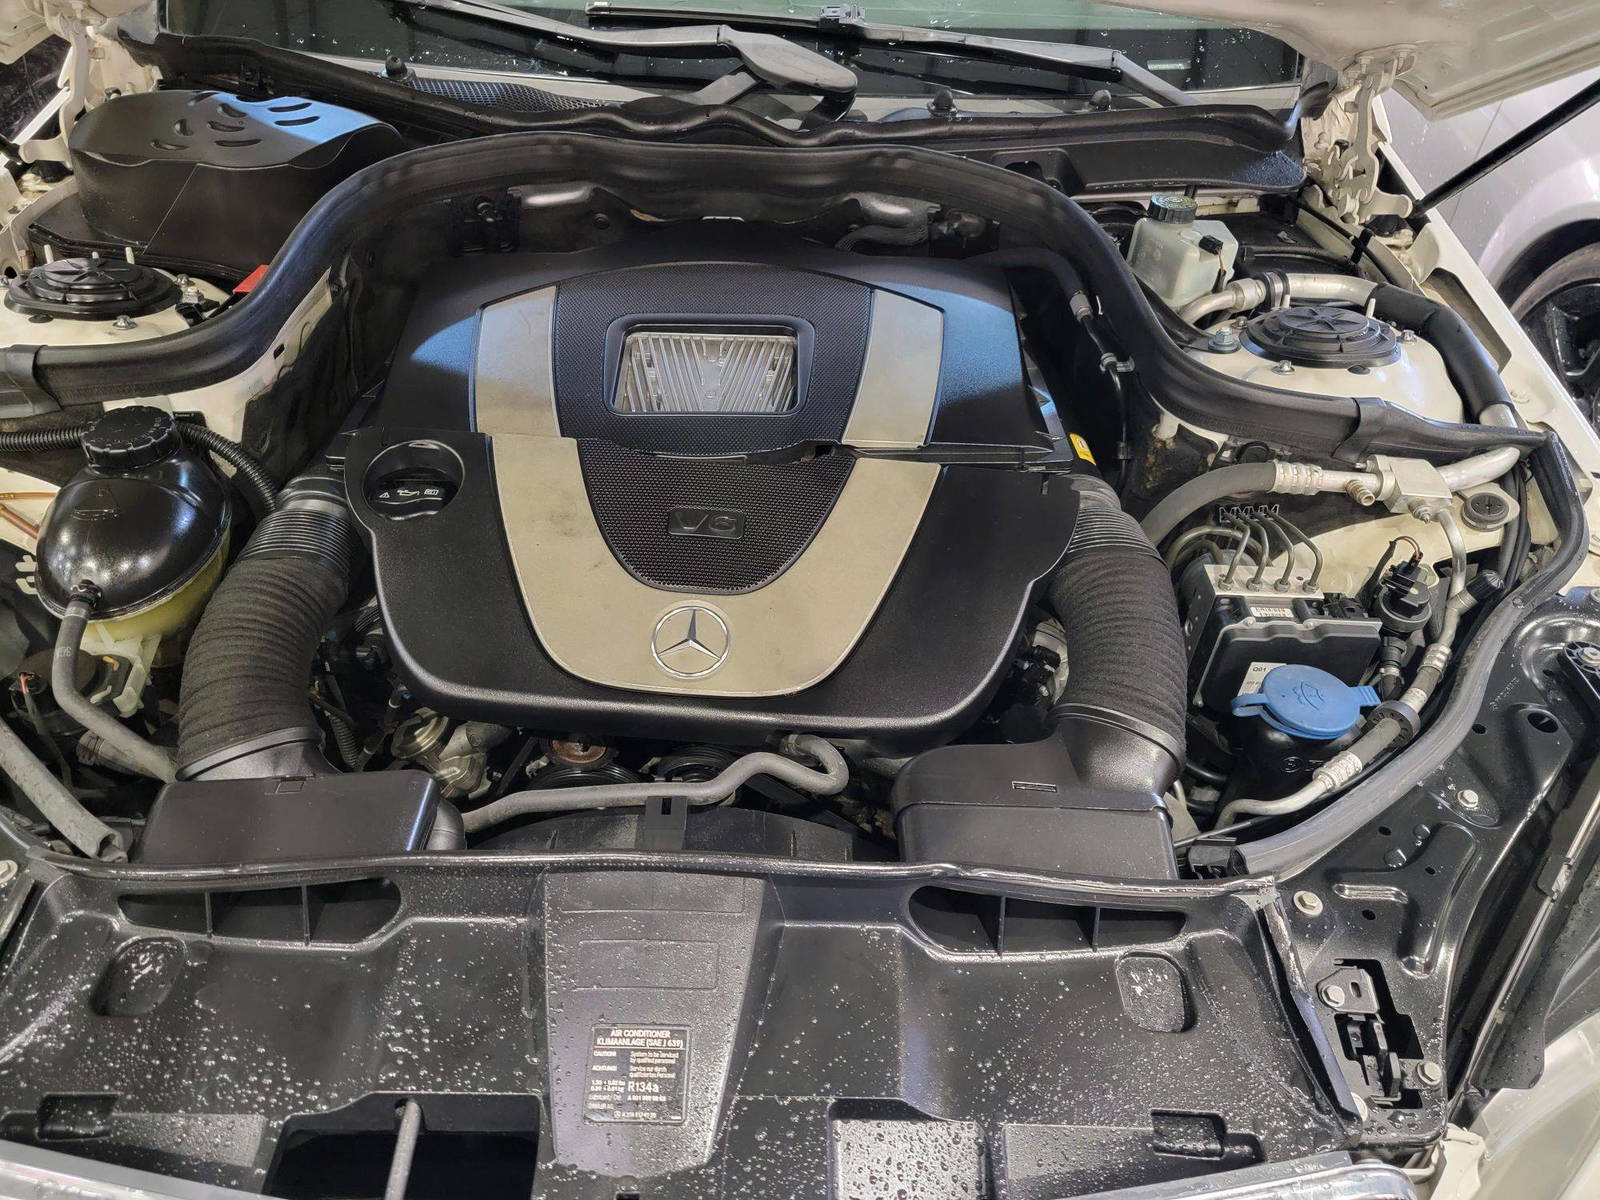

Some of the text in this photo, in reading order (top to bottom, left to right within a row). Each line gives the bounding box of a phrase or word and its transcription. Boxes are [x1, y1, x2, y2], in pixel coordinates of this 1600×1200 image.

[675, 513, 737, 532] V6
[624, 1030, 671, 1038] CONDITIONER
[596, 1038, 645, 1046] KLIMAANLAGE
[646, 1039, 662, 1048] (SAE
[667, 1040, 683, 1048] 639)
[627, 1081, 659, 1093] R134a
